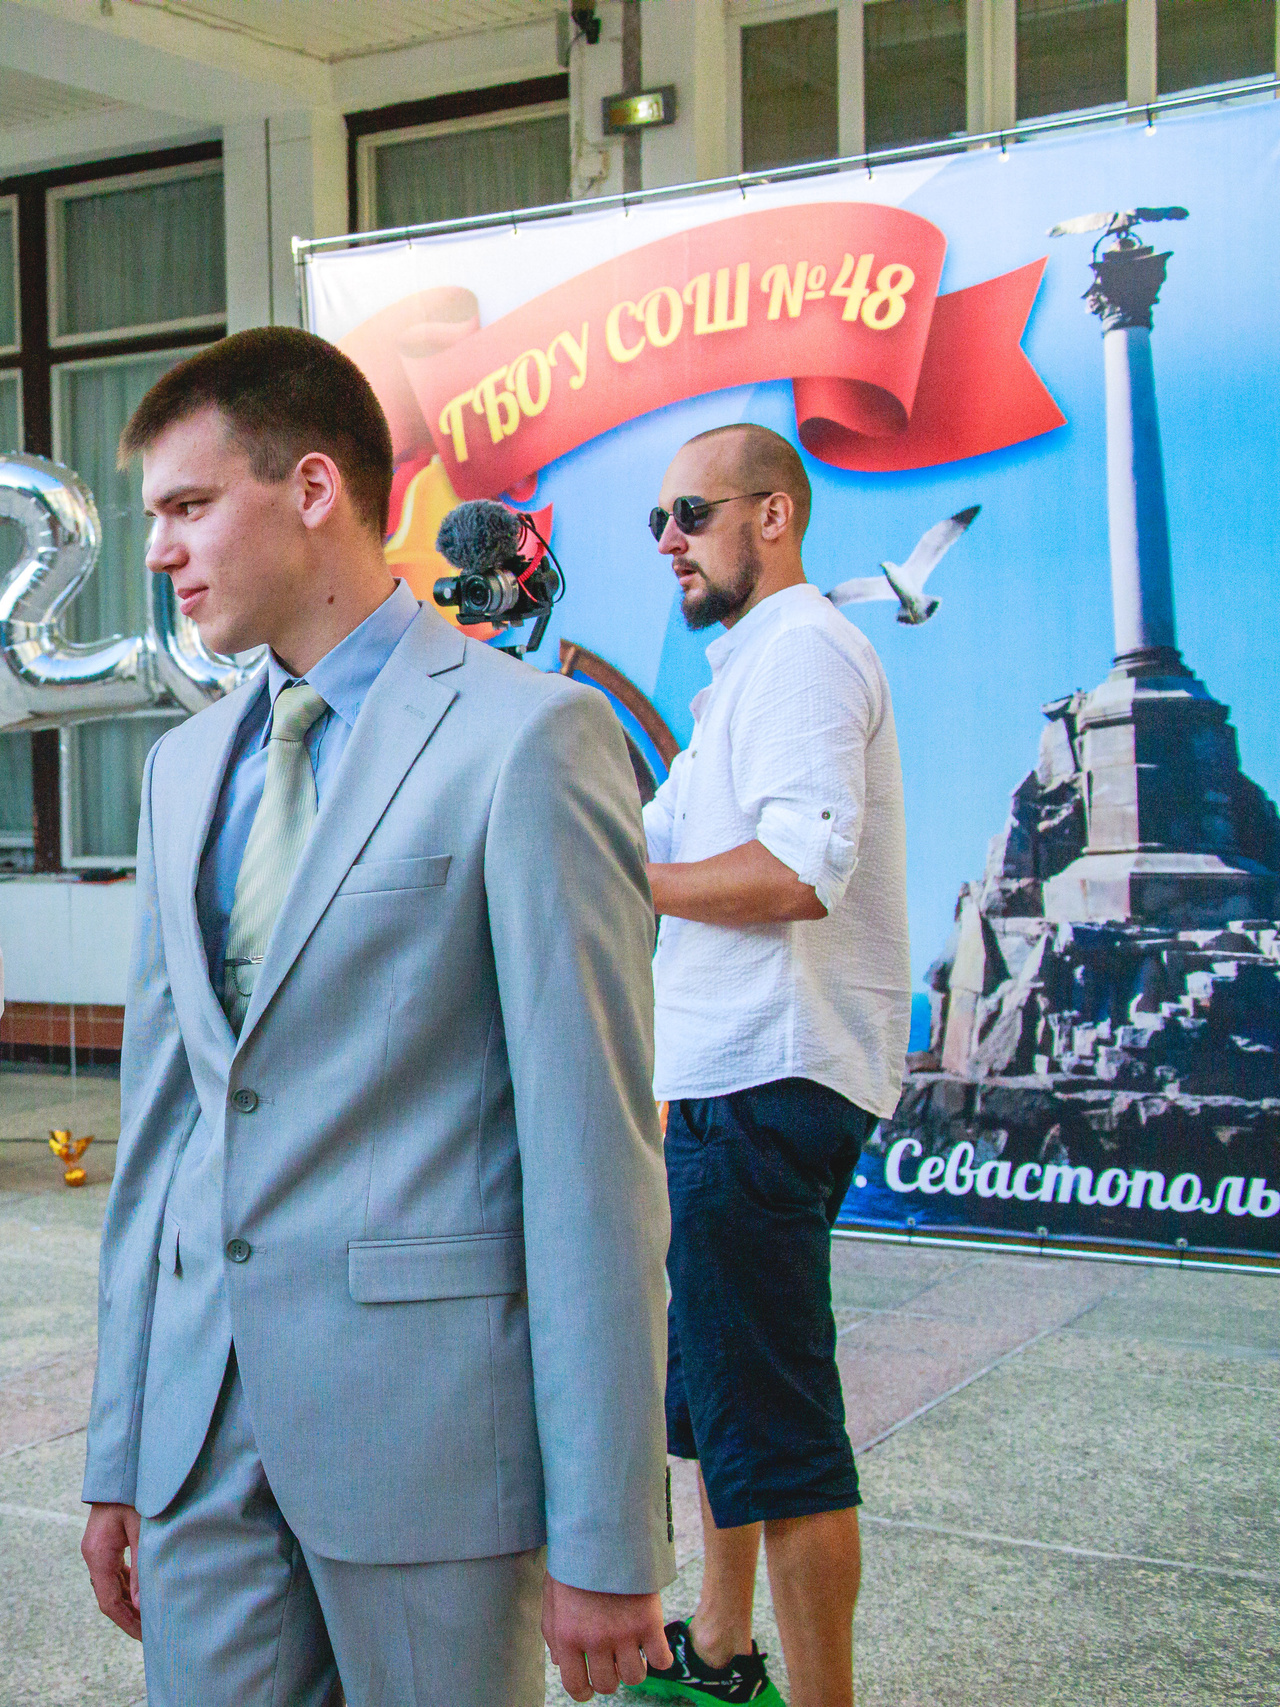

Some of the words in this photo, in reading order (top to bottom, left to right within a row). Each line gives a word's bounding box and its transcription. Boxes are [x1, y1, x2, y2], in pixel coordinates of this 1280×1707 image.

[439, 321, 589, 463] ГБОУ
[605, 262, 751, 363] СОШ
[884, 1138, 1280, 1218] Севастополь
